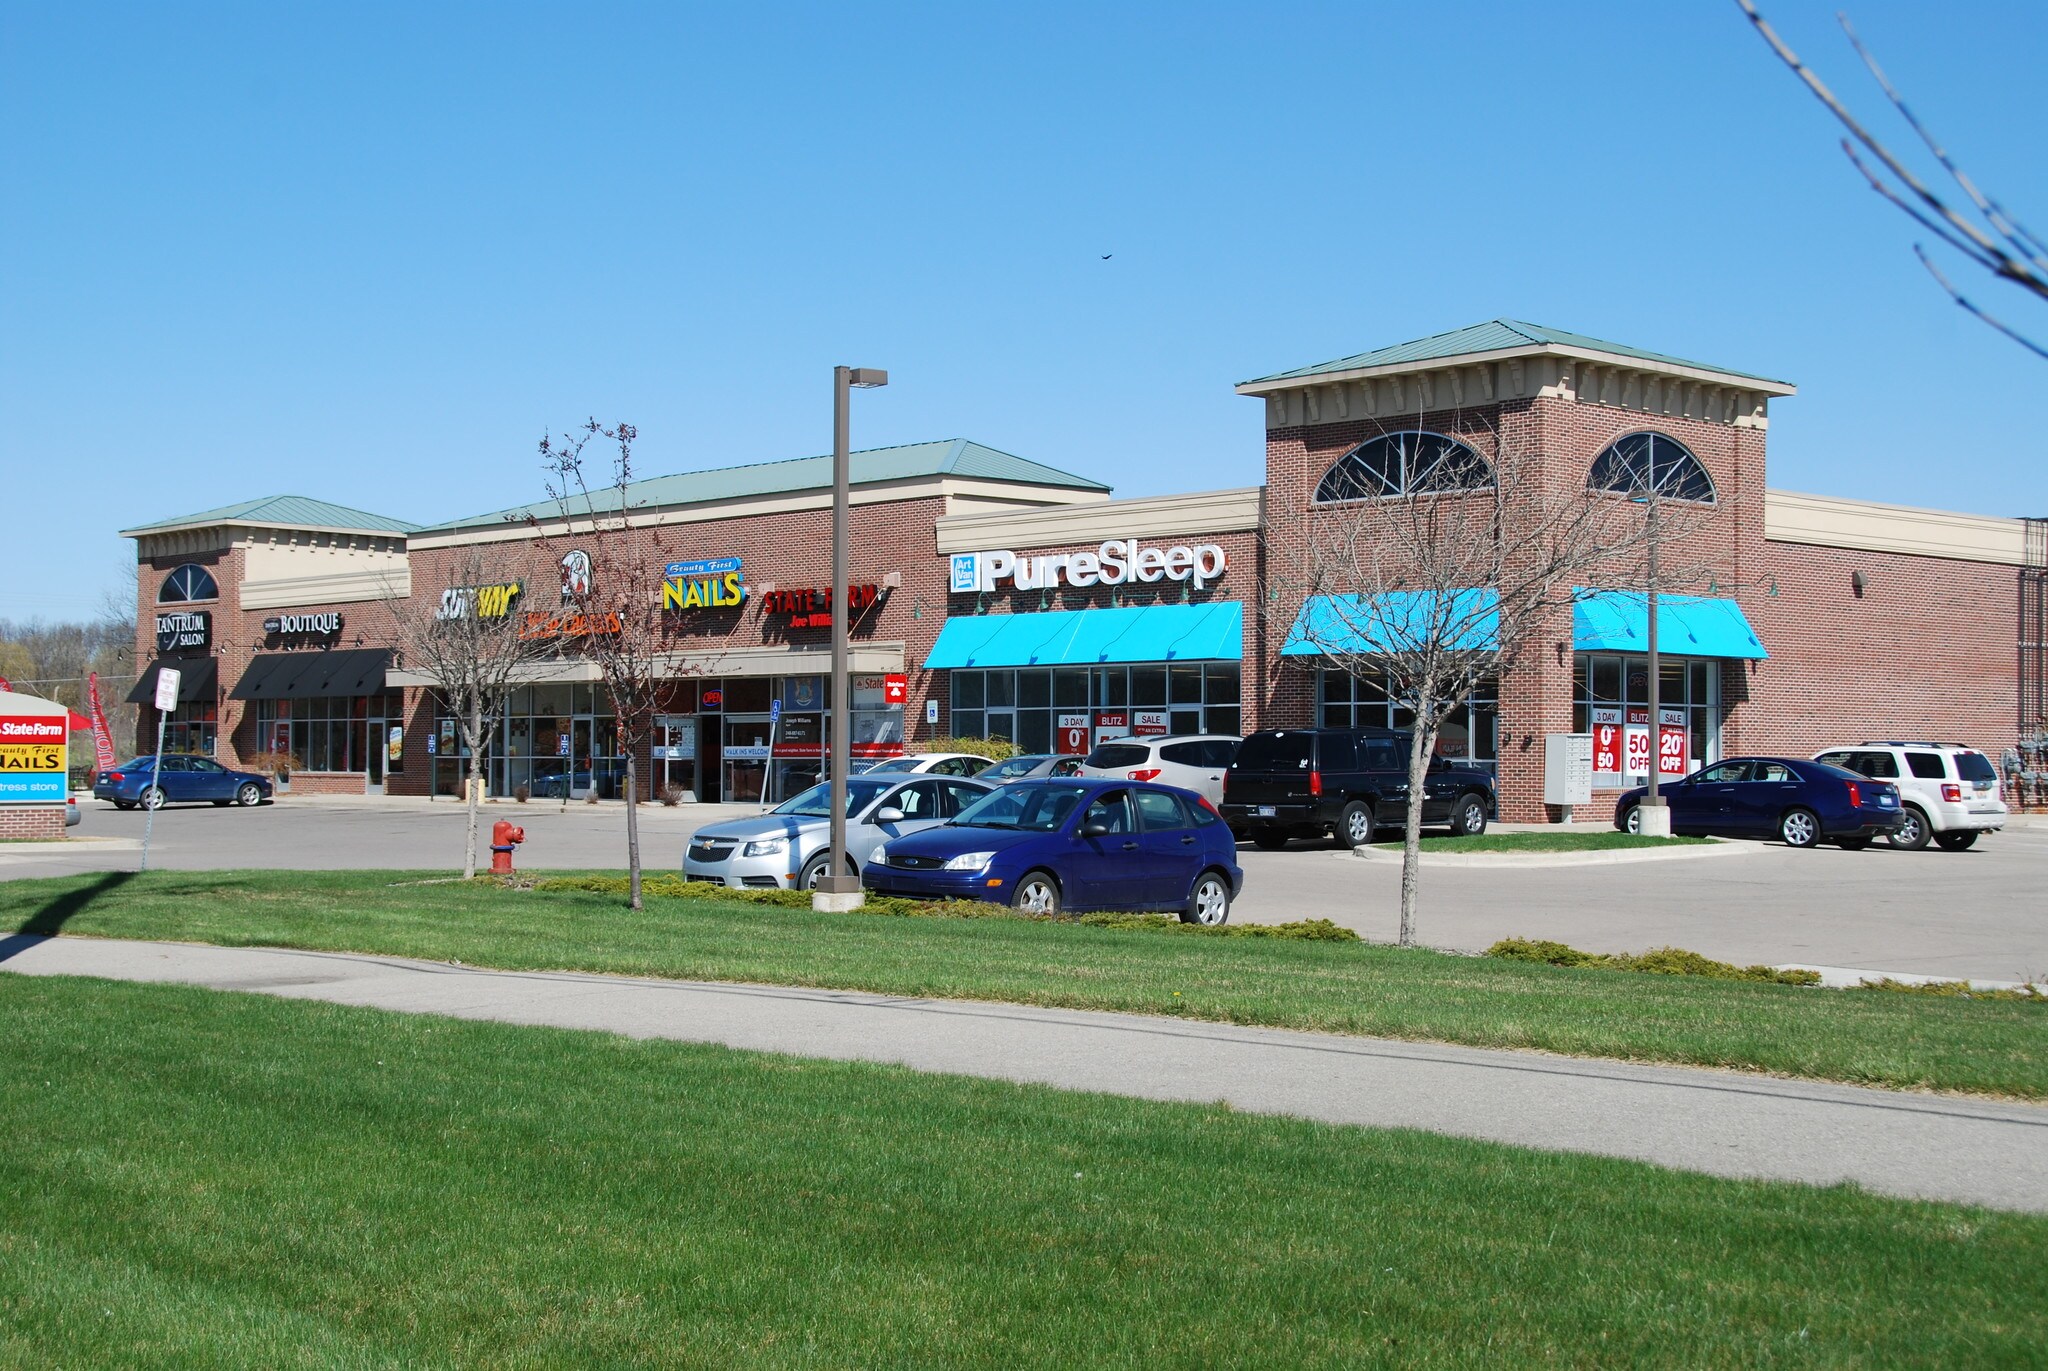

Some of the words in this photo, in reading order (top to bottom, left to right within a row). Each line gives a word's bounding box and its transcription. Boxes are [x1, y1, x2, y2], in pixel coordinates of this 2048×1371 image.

[669, 564, 705, 573] Beauty
[707, 561, 732, 571] First
[957, 559, 972, 569] Art
[981, 539, 1226, 592] PureSleep
[957, 570, 973, 580] Van
[663, 572, 742, 610] NAILS
[435, 582, 519, 620] SUWAY
[764, 591, 815, 615] STATE
[824, 584, 877, 611] FRM
[155, 615, 205, 633] TANTRUM
[280, 612, 339, 635] BOUTIQUE
[789, 615, 808, 627] Joe
[180, 633, 205, 646] SALON
[1064, 718, 1069, 726] 3
[1070, 718, 1084, 726] DAY
[1101, 717, 1123, 726] BLITZ
[1142, 715, 1161, 724] SALE
[1596, 712, 1601, 721] 3
[1602, 713, 1616, 722] DAY
[1664, 714, 1682, 723] SALE
[32, 745, 60, 755] First
[1629, 734, 1649, 754] 50
[1597, 751, 1614, 768] 50
[1660, 755, 1682, 771] OFF
[30, 783, 59, 791] store
